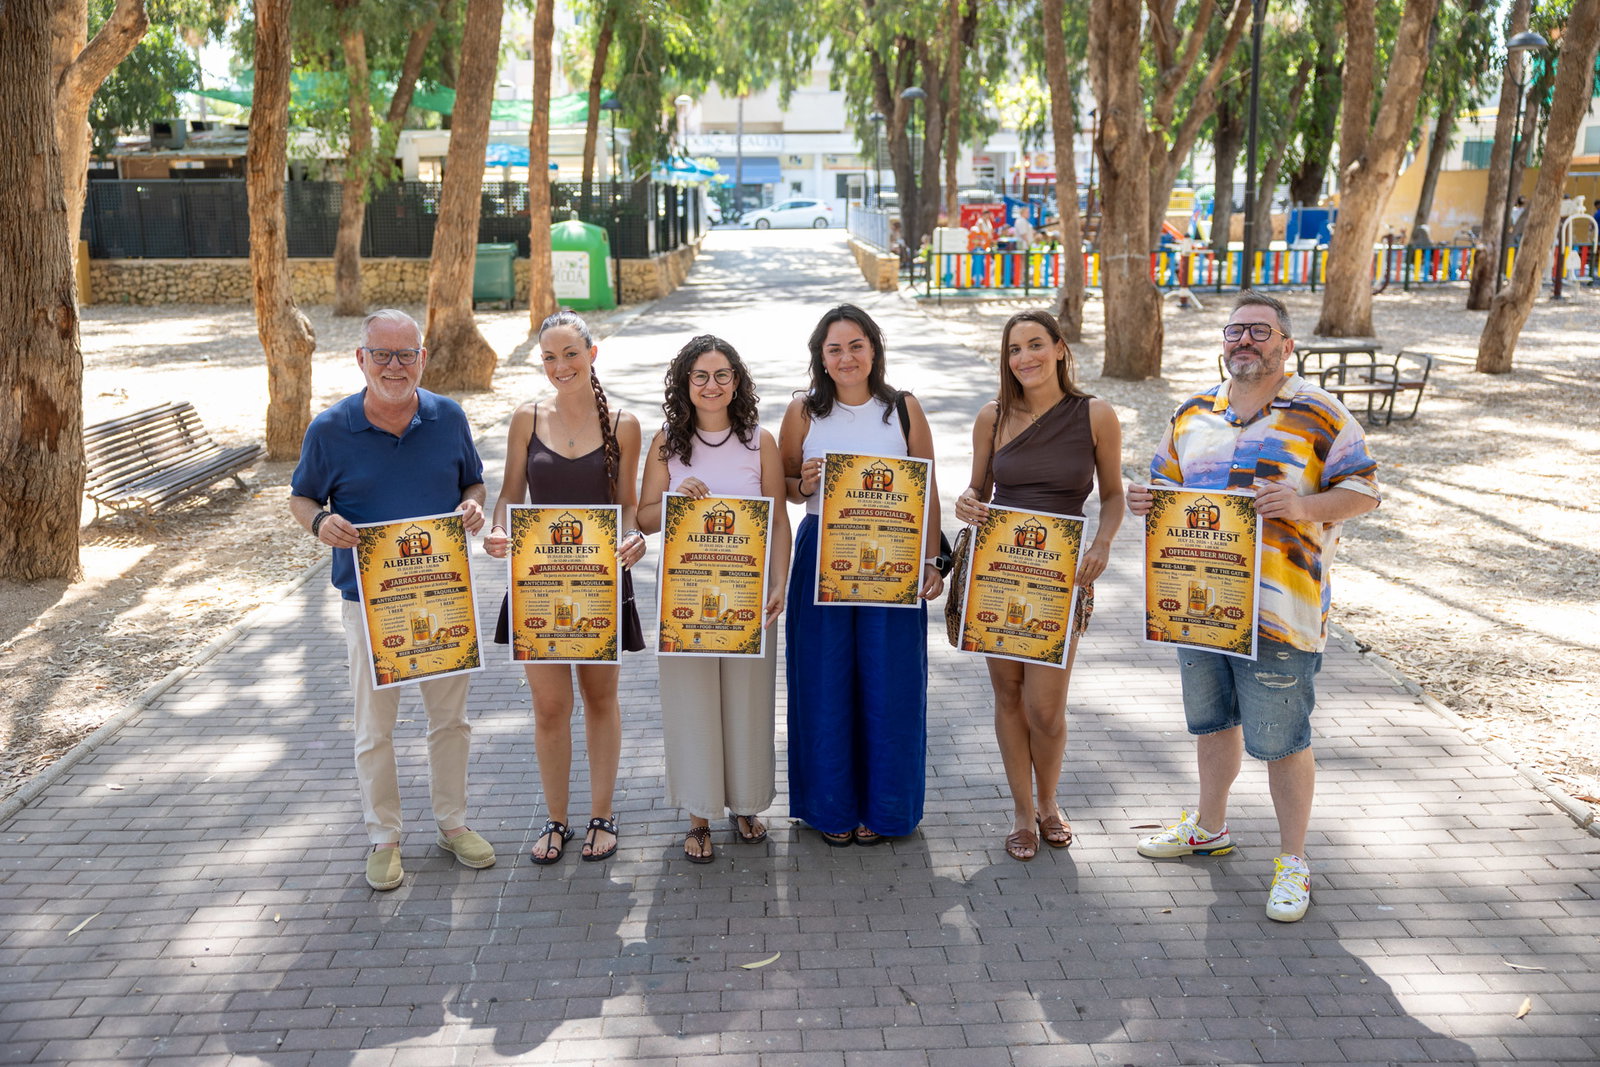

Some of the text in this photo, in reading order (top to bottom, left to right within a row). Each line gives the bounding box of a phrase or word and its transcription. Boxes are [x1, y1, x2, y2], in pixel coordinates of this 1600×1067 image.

[730, 134, 782, 147] BAUTY
[845, 490, 909, 502] ALBEER FEST
[875, 510, 907, 519] OFICIALES
[686, 534, 751, 545] ALBEER FEST
[1166, 528, 1240, 543] ALBEER FEST
[534, 546, 600, 554] ALBEER FEST
[996, 544, 1035, 557] ALBEER
[1037, 550, 1062, 561] FEST
[1168, 547, 1238, 561] OFFICIAL BEER MUGS
[384, 553, 451, 570] ALBEER FEST
[716, 554, 749, 562] OFICIALES
[998, 562, 1024, 572] JARRAS
[1025, 566, 1059, 578] OFICIALES
[390, 577, 417, 587] JARRAS
[418, 572, 452, 583] OFICIALES
[982, 576, 1015, 585] ANTICIPADAS
[376, 595, 412, 604] ANTICIPADAS
[1162, 601, 1176, 609] €12
[980, 613, 996, 622] 12€
[1227, 609, 1241, 618] €15
[451, 626, 467, 636] 15€
[1043, 622, 1058, 631] 15€
[386, 637, 402, 646] 12€
